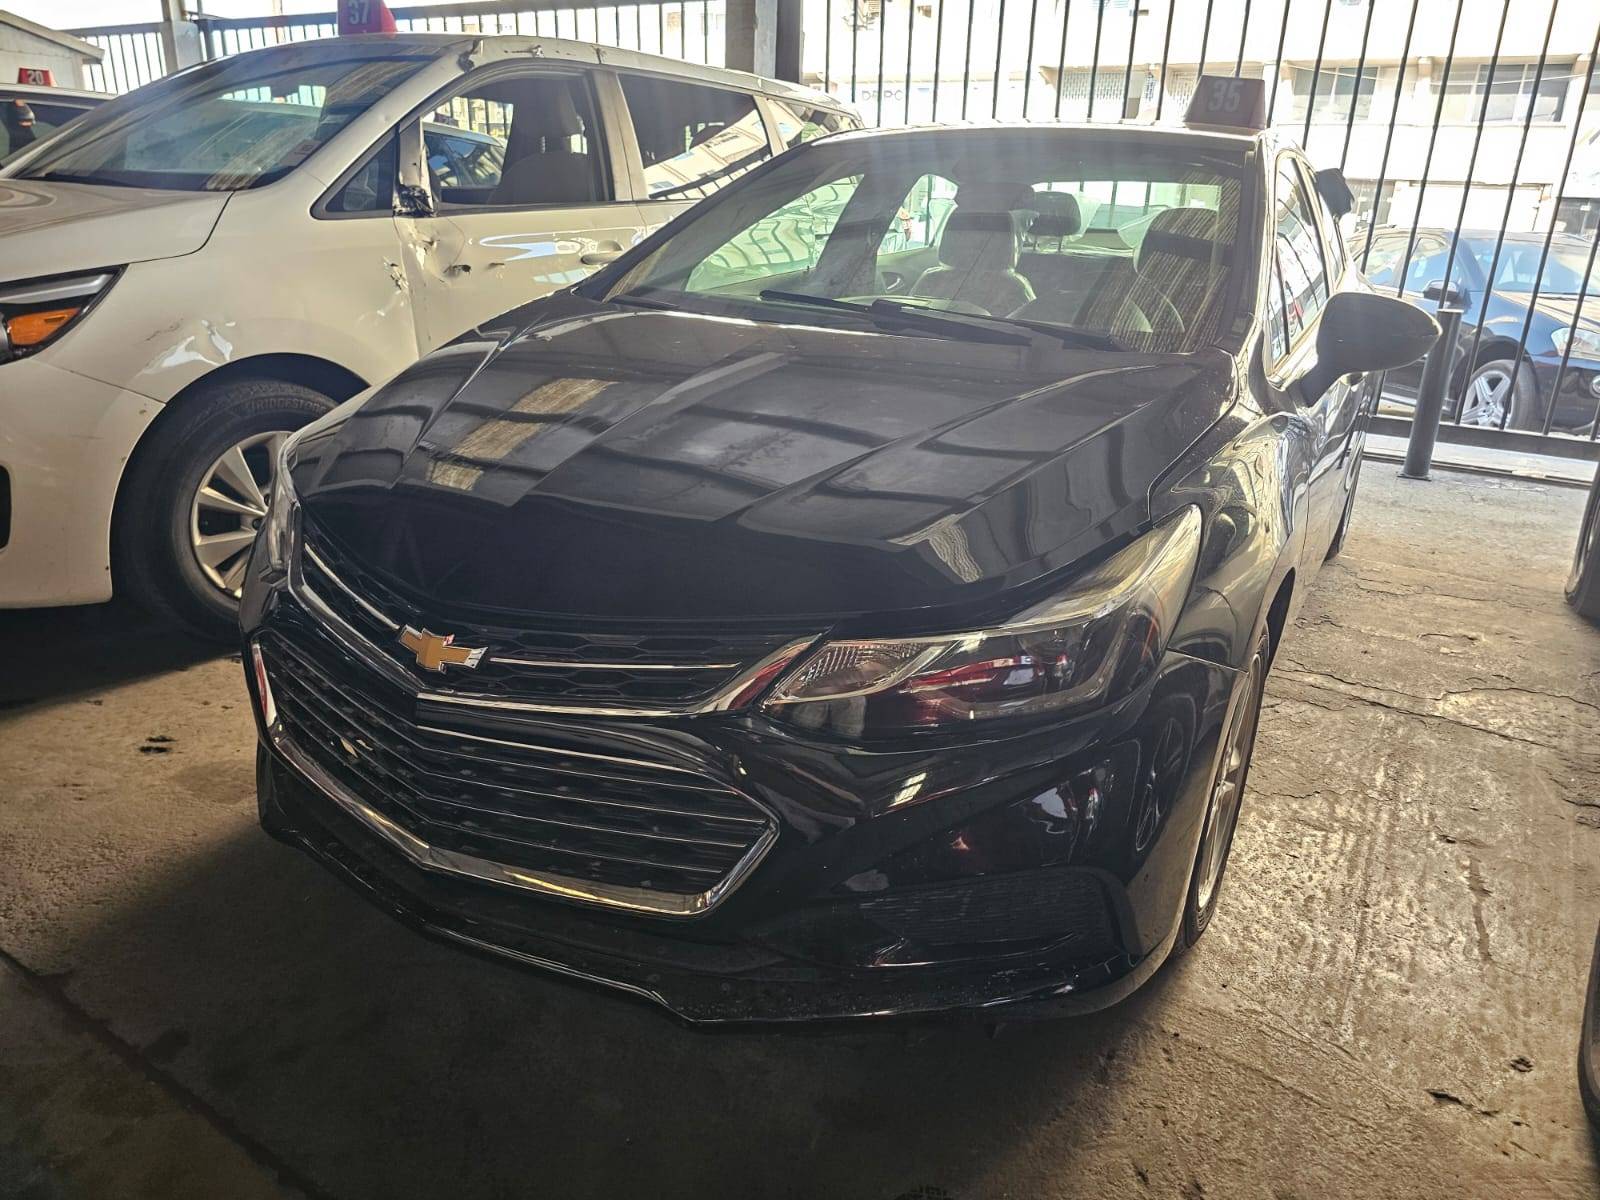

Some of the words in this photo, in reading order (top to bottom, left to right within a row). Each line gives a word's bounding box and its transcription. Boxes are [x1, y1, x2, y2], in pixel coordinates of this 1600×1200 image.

[349, 0, 369, 24] 37
[28, 70, 44, 85] 20
[1207, 80, 1244, 112] 35
